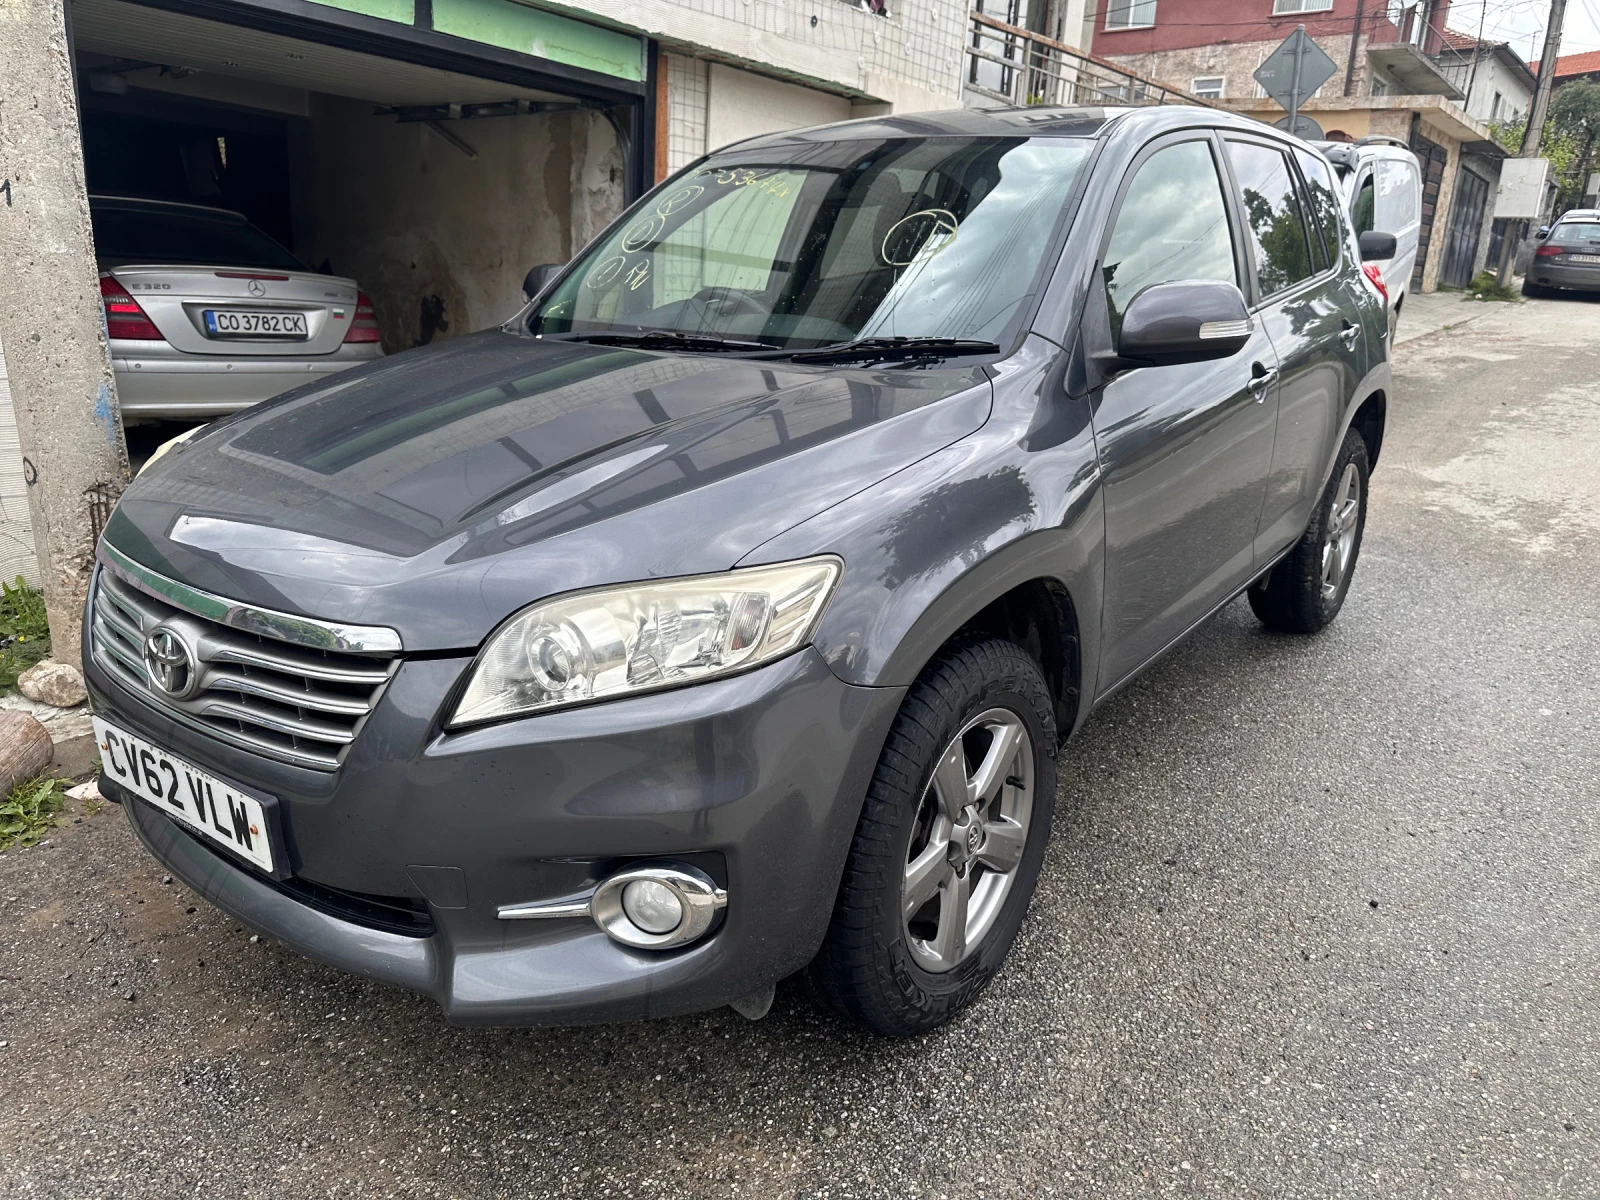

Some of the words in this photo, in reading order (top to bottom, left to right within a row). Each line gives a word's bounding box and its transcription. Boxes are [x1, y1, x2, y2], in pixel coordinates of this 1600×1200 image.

[217, 314, 240, 331] CO
[242, 315, 281, 332] 3782
[283, 316, 303, 332] CK
[105, 730, 185, 811] CV62
[184, 770, 253, 852] VLW
